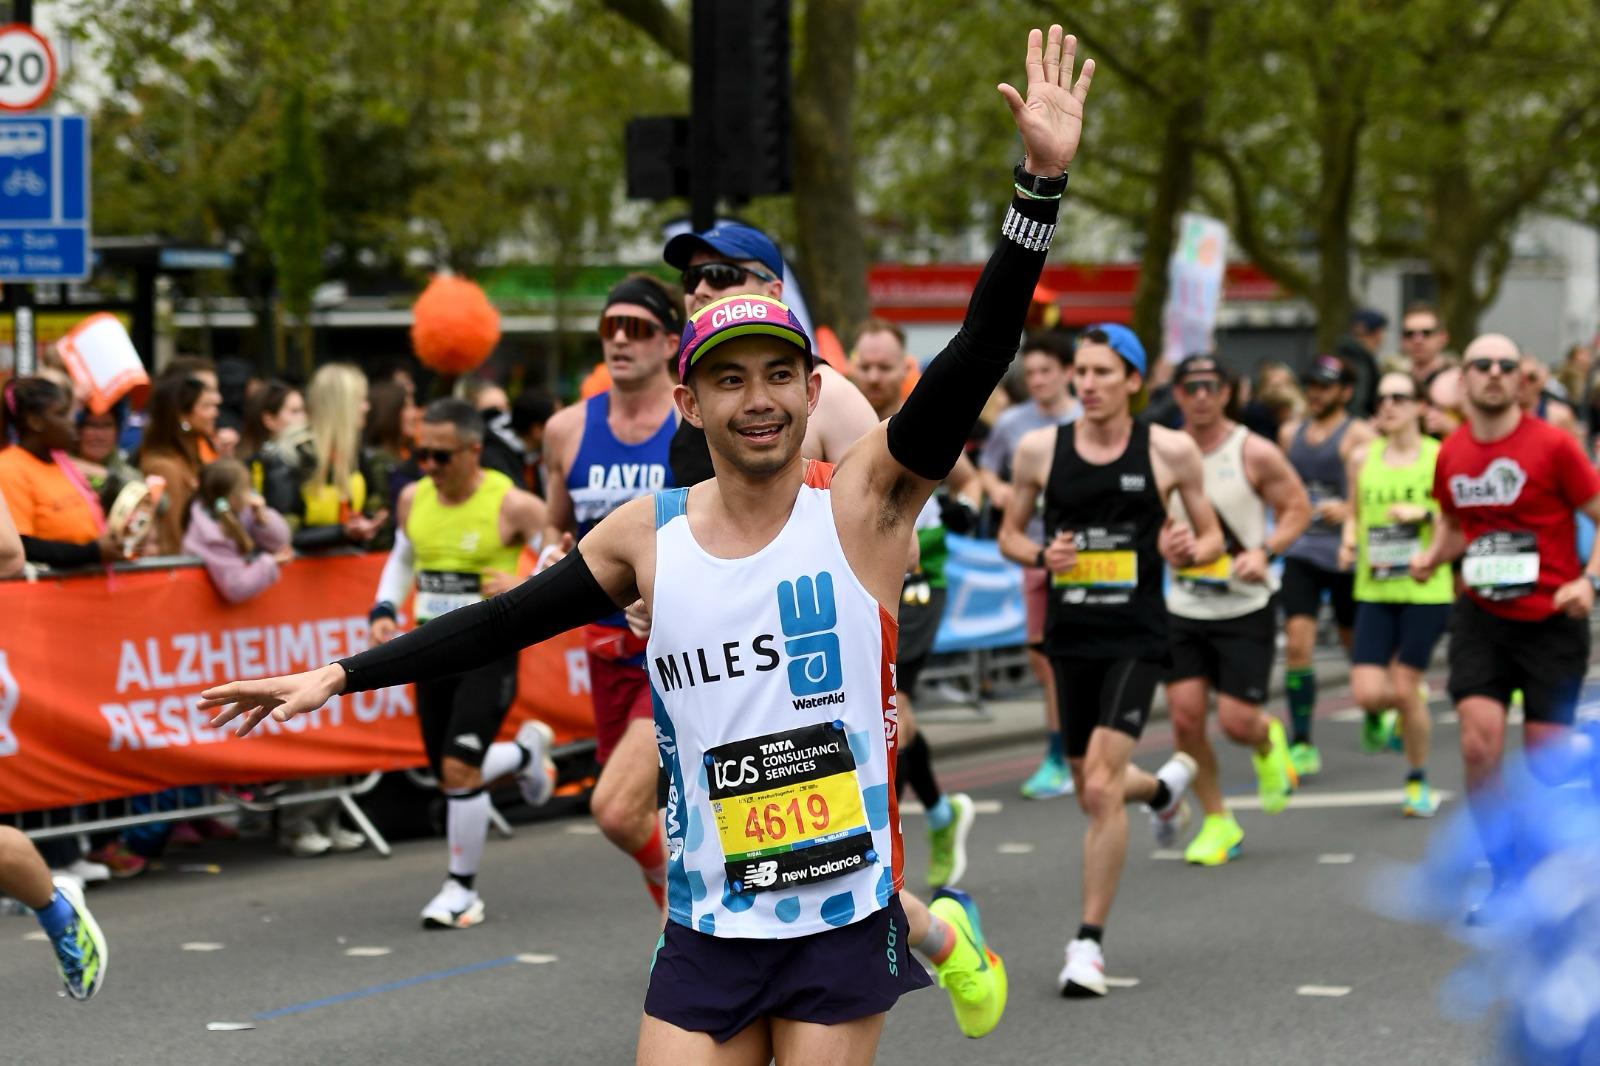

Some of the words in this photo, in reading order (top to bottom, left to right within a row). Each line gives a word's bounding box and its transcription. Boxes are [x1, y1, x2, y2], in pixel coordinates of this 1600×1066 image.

[588, 463, 666, 490] DAVID
[655, 634, 780, 692] MILES
[793, 692, 845, 710] WaterAid
[102, 691, 343, 751] RESEA
[760, 739, 795, 755] TATA
[763, 742, 840, 767] CONSULTANCY
[765, 761, 817, 780] SERVICES
[745, 793, 830, 843] 4619
[782, 868, 808, 883] new
[810, 854, 861, 877] balance
[886, 917, 899, 977] soar
